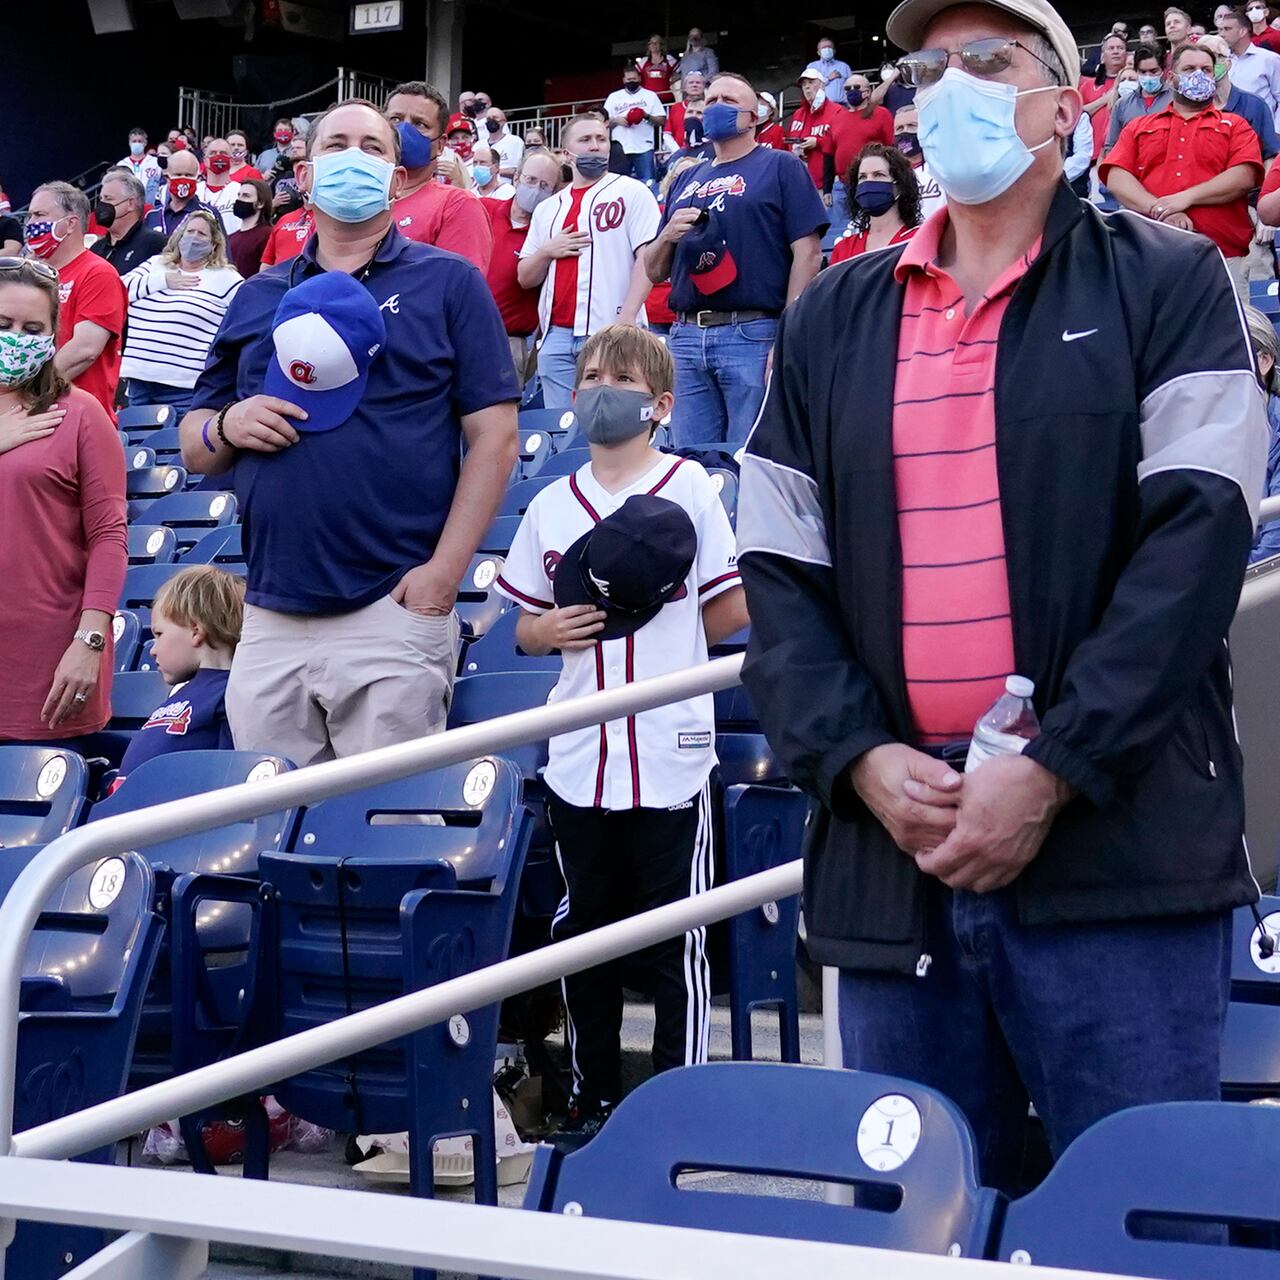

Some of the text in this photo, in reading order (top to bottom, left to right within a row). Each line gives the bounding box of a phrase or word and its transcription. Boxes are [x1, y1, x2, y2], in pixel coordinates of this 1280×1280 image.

[363, 5, 393, 24] 117
[593, 197, 626, 232] W
[44, 769, 59, 780] 16
[472, 776, 488, 791] 18
[98, 874, 118, 893] 18
[456, 1023, 462, 1035] F
[883, 1119, 895, 1146] 1
